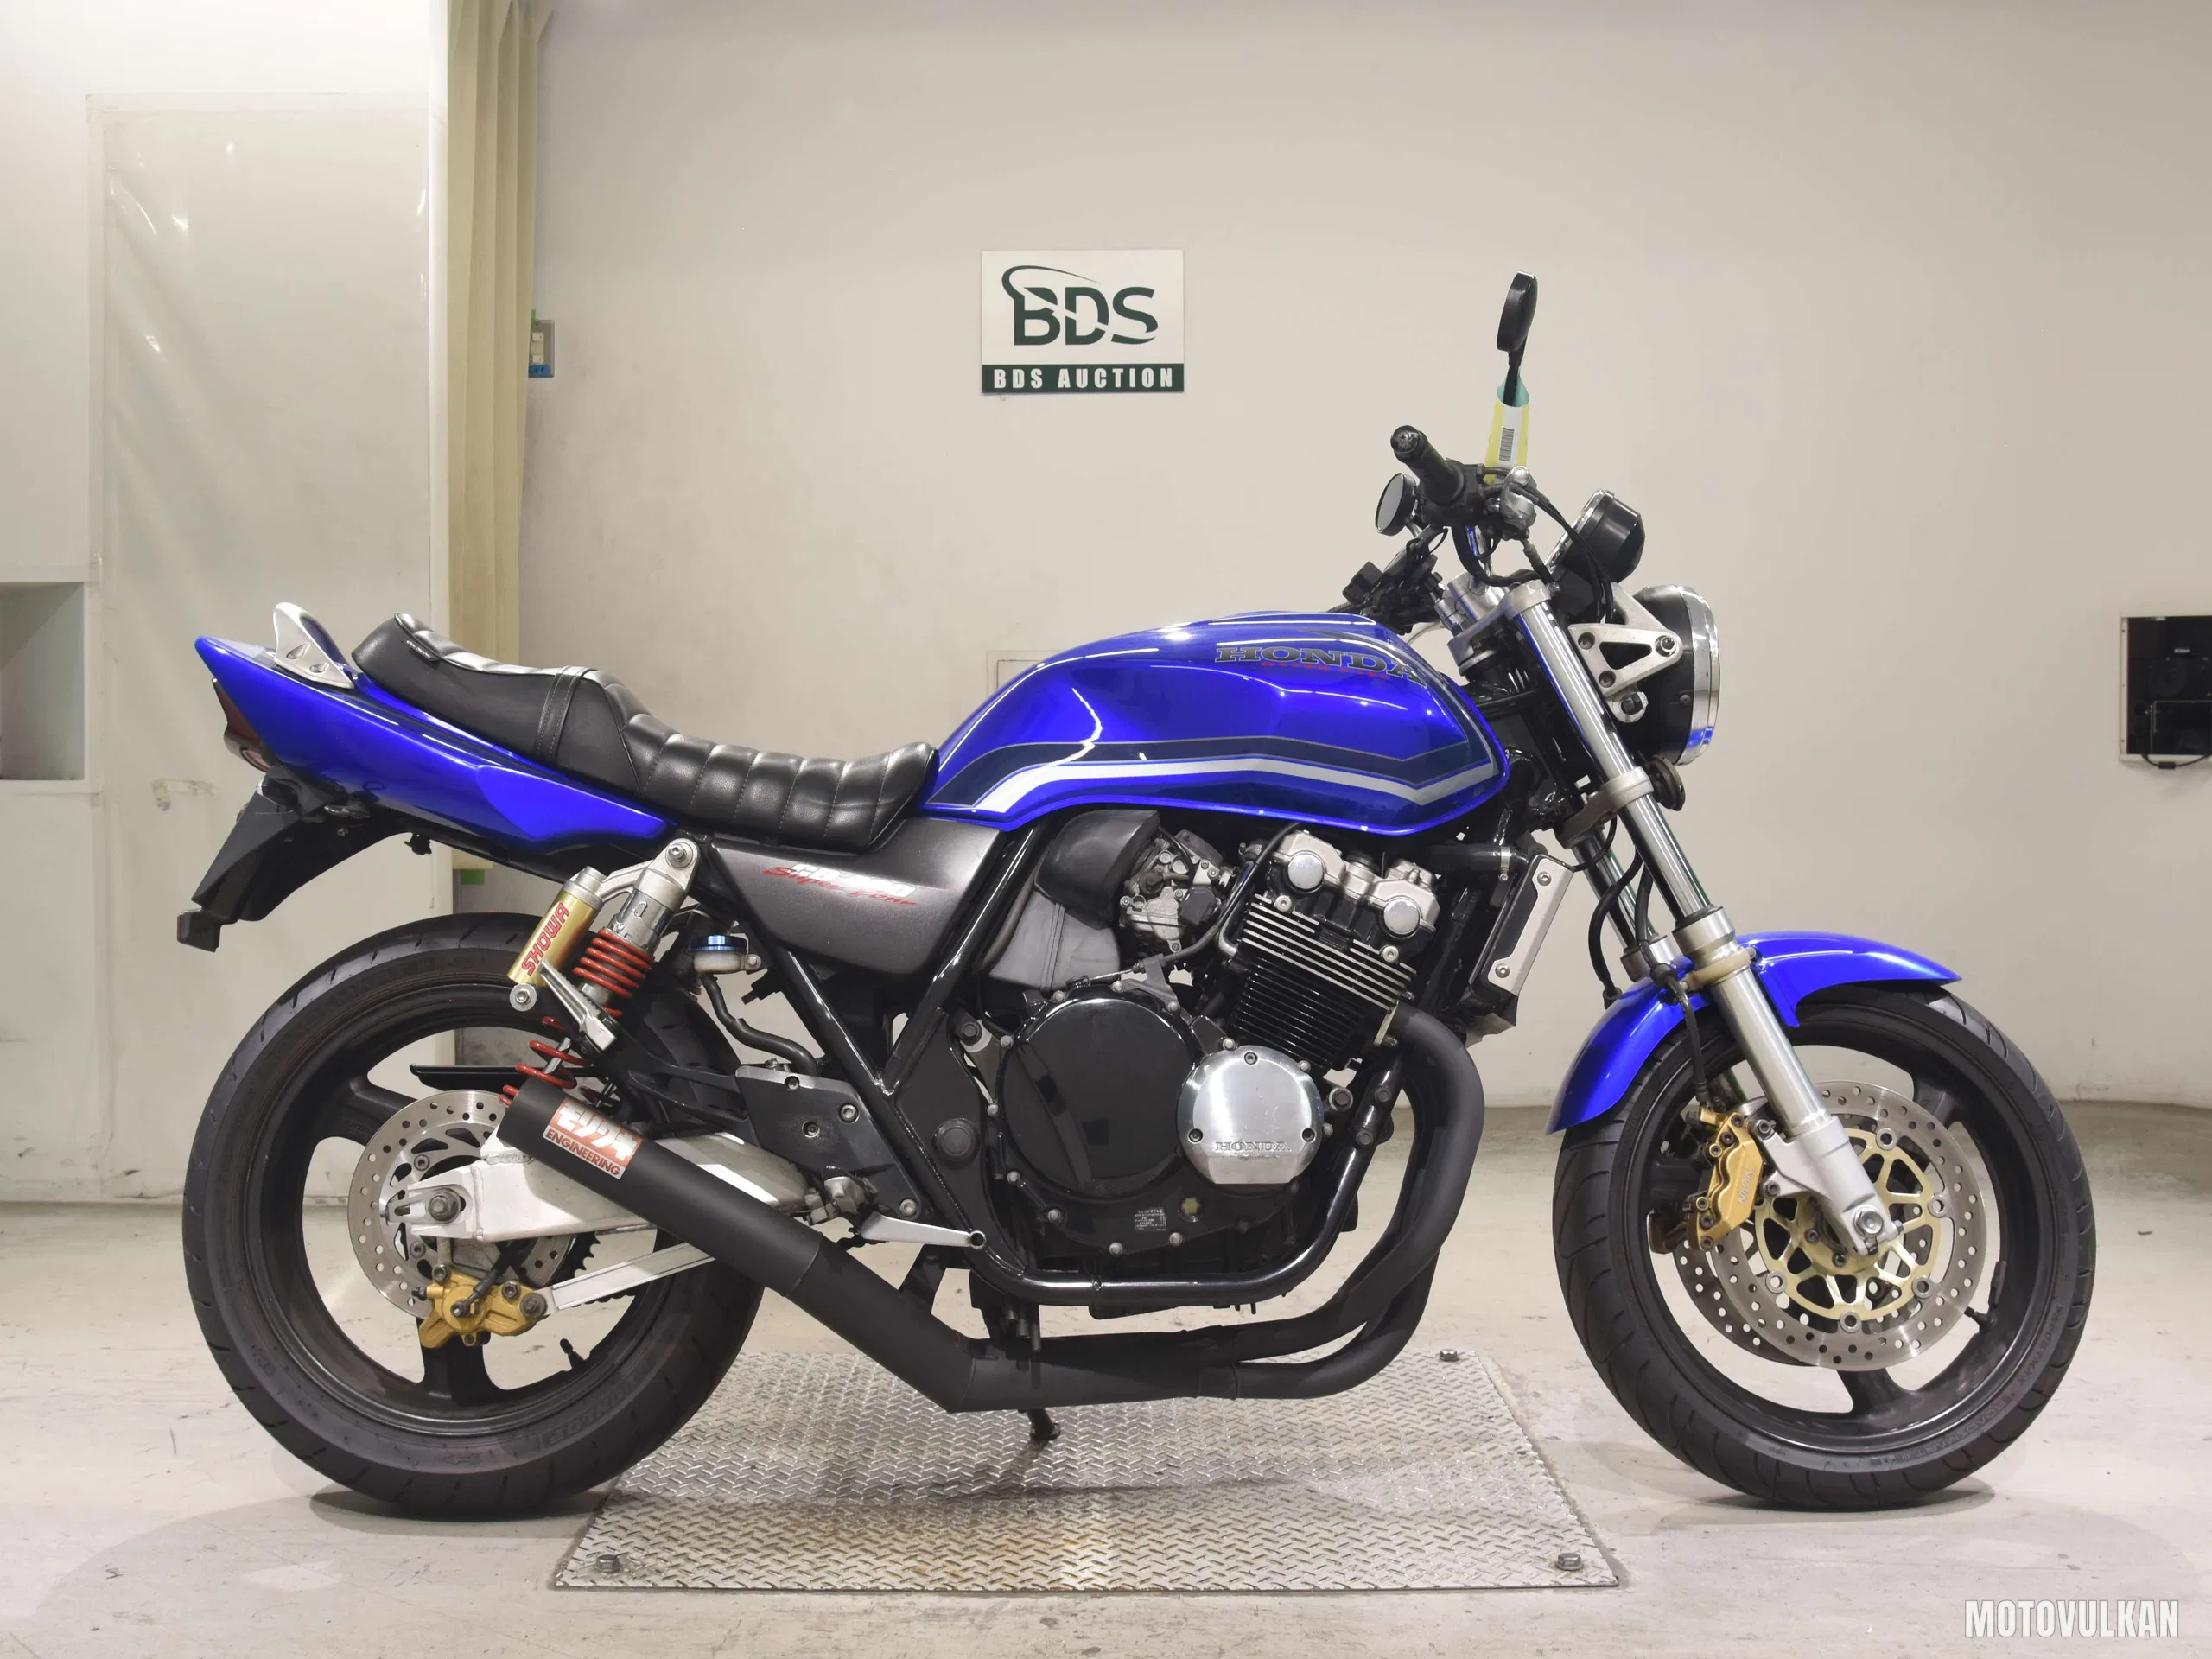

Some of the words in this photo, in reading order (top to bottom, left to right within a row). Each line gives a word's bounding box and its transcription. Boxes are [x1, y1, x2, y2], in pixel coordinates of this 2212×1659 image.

[1001, 265, 1159, 346] BDS
[994, 368, 1043, 389] BDS
[1058, 367, 1173, 389] AUCTION
[1215, 646, 1427, 689] HONDA
[521, 902, 570, 976] SHOWA
[545, 1129, 622, 1177] ENGINEERING
[1215, 1141, 1291, 1152] HONDA
